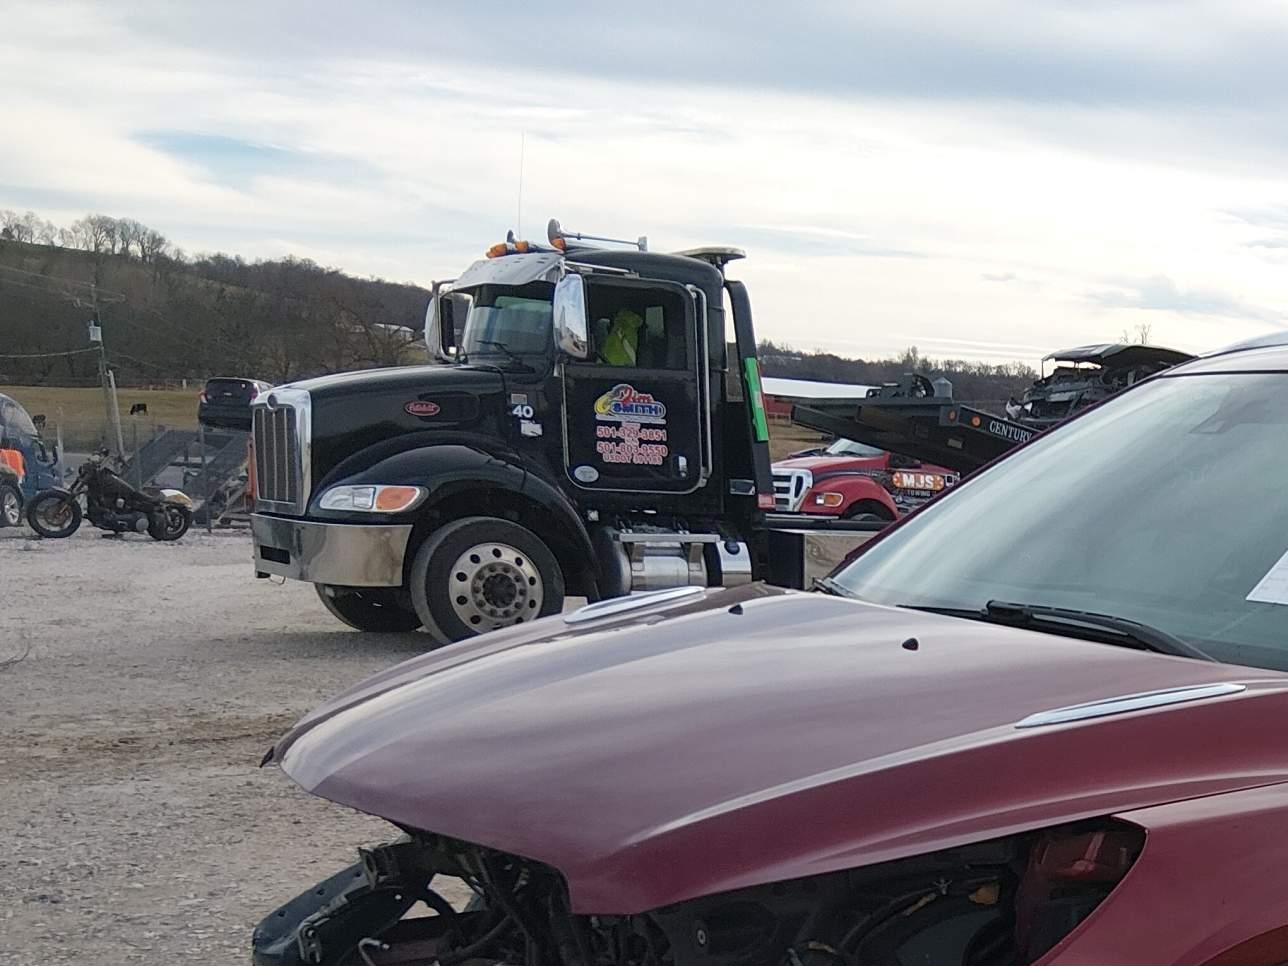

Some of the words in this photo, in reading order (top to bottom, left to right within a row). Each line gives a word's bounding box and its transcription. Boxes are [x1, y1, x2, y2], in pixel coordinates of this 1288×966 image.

[512, 405, 534, 418] 40
[613, 402, 659, 414] SMITH
[990, 420, 1033, 443] CENTURY
[902, 473, 934, 489] MJS
